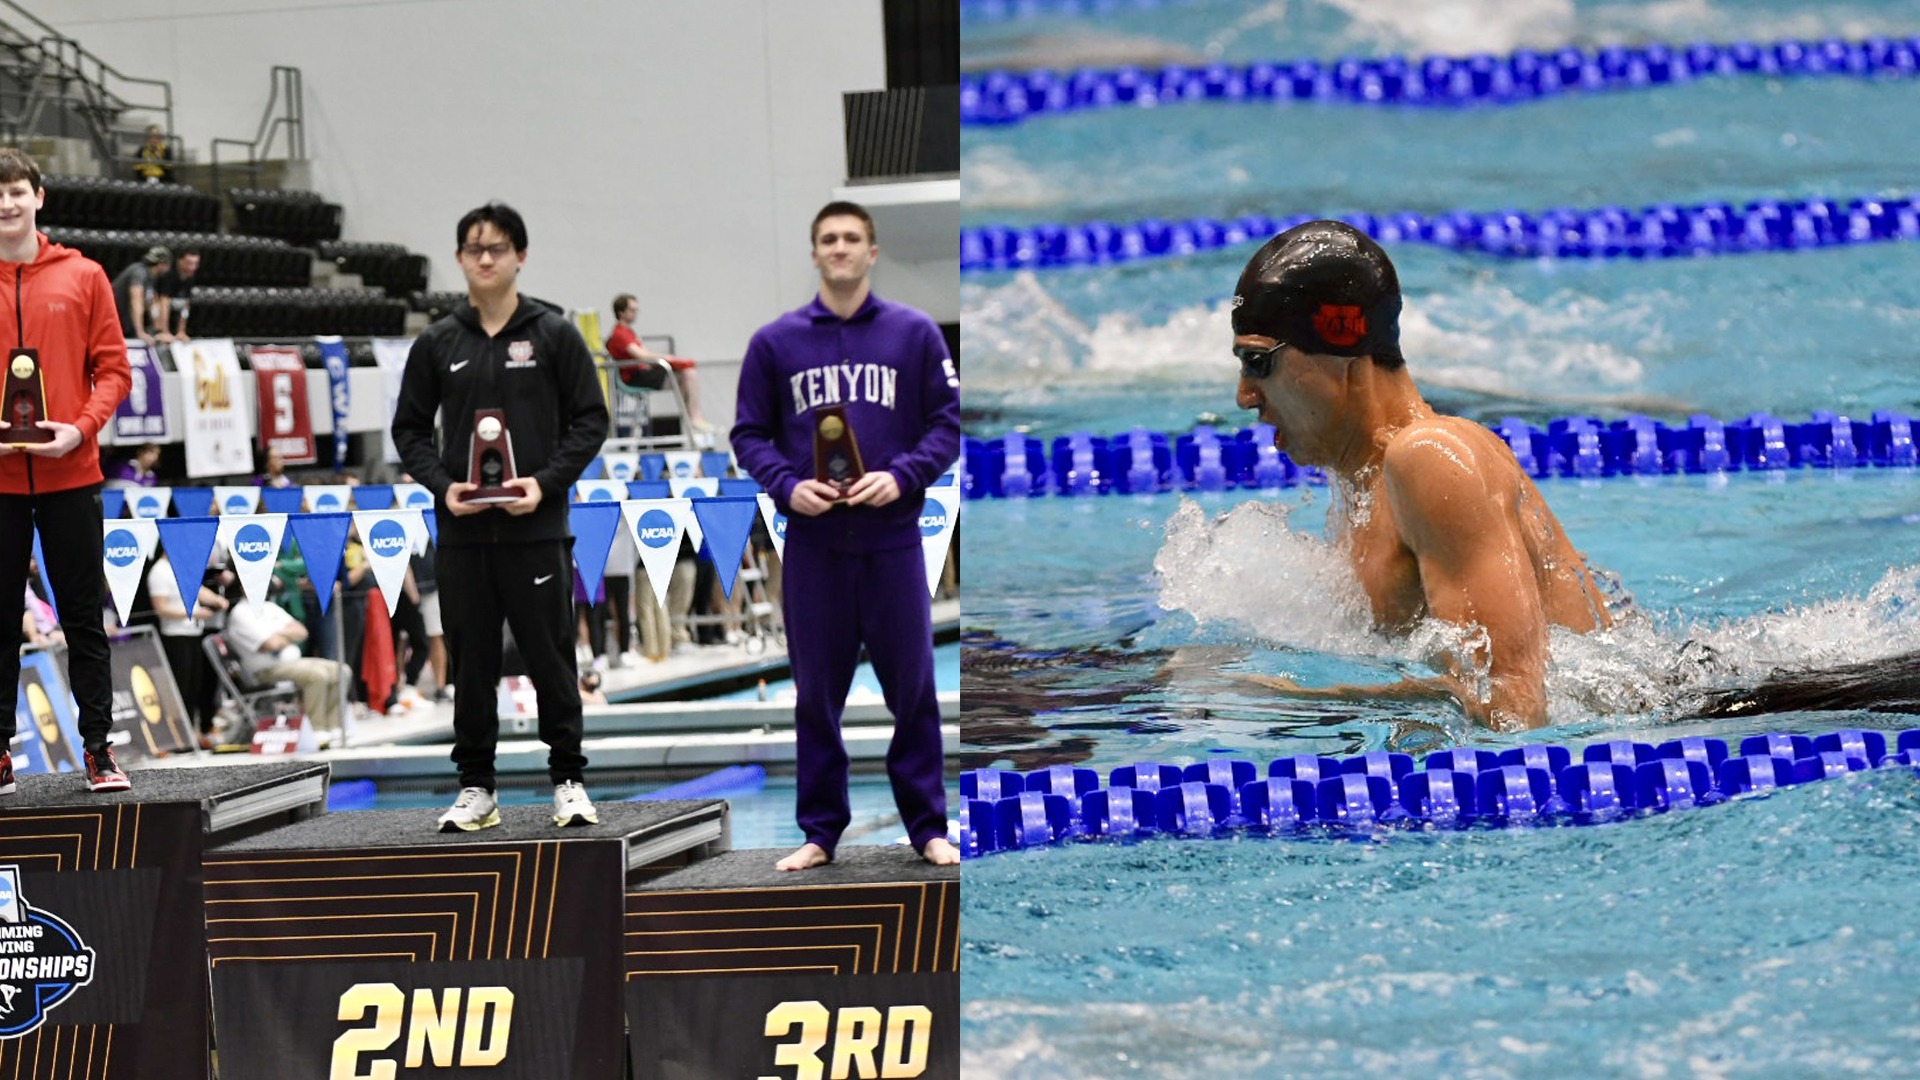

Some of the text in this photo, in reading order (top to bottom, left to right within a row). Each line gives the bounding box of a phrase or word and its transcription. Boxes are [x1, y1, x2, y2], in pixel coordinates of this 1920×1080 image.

[789, 363, 898, 415] KENYON
[918, 516, 947, 528] CAA
[641, 527, 675, 540] NCAA
[238, 541, 271, 554] NCAA
[373, 536, 406, 549] NCAA
[105, 545, 139, 559] NCAA
[0, 925, 44, 939] MING
[329, 982, 515, 1080] 2ND
[757, 1000, 933, 1080] 3RD
